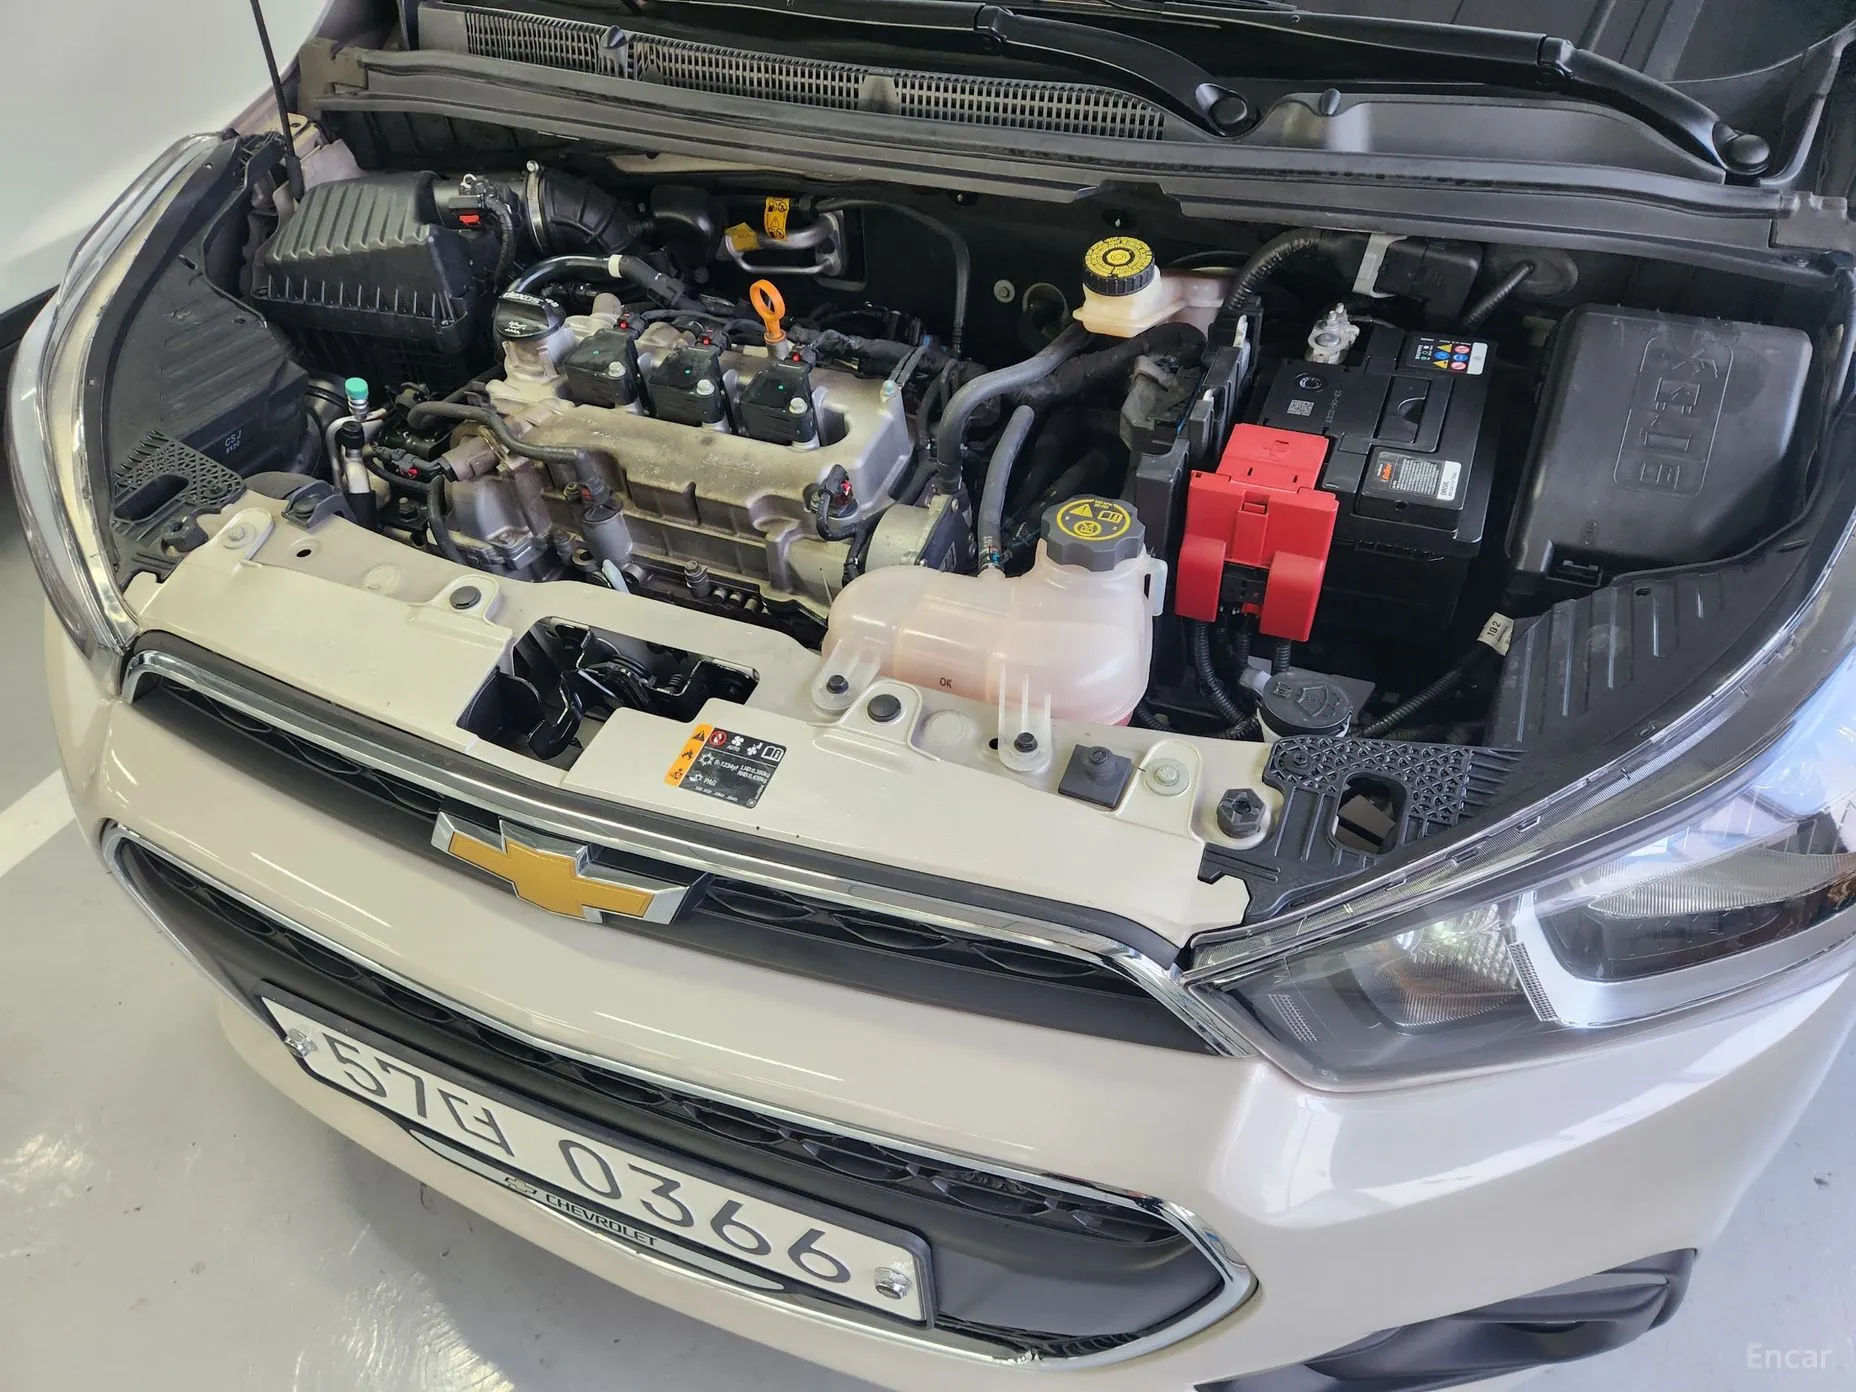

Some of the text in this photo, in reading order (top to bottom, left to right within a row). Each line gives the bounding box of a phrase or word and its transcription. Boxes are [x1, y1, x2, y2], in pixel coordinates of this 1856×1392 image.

[1487, 620, 1501, 637] 102
[939, 677, 952, 689] OK
[726, 744, 741, 752] AUTO
[703, 777, 717, 787] PAG
[322, 1032, 851, 1283] 57더 0366
[545, 1193, 658, 1247] CHEVROLET
